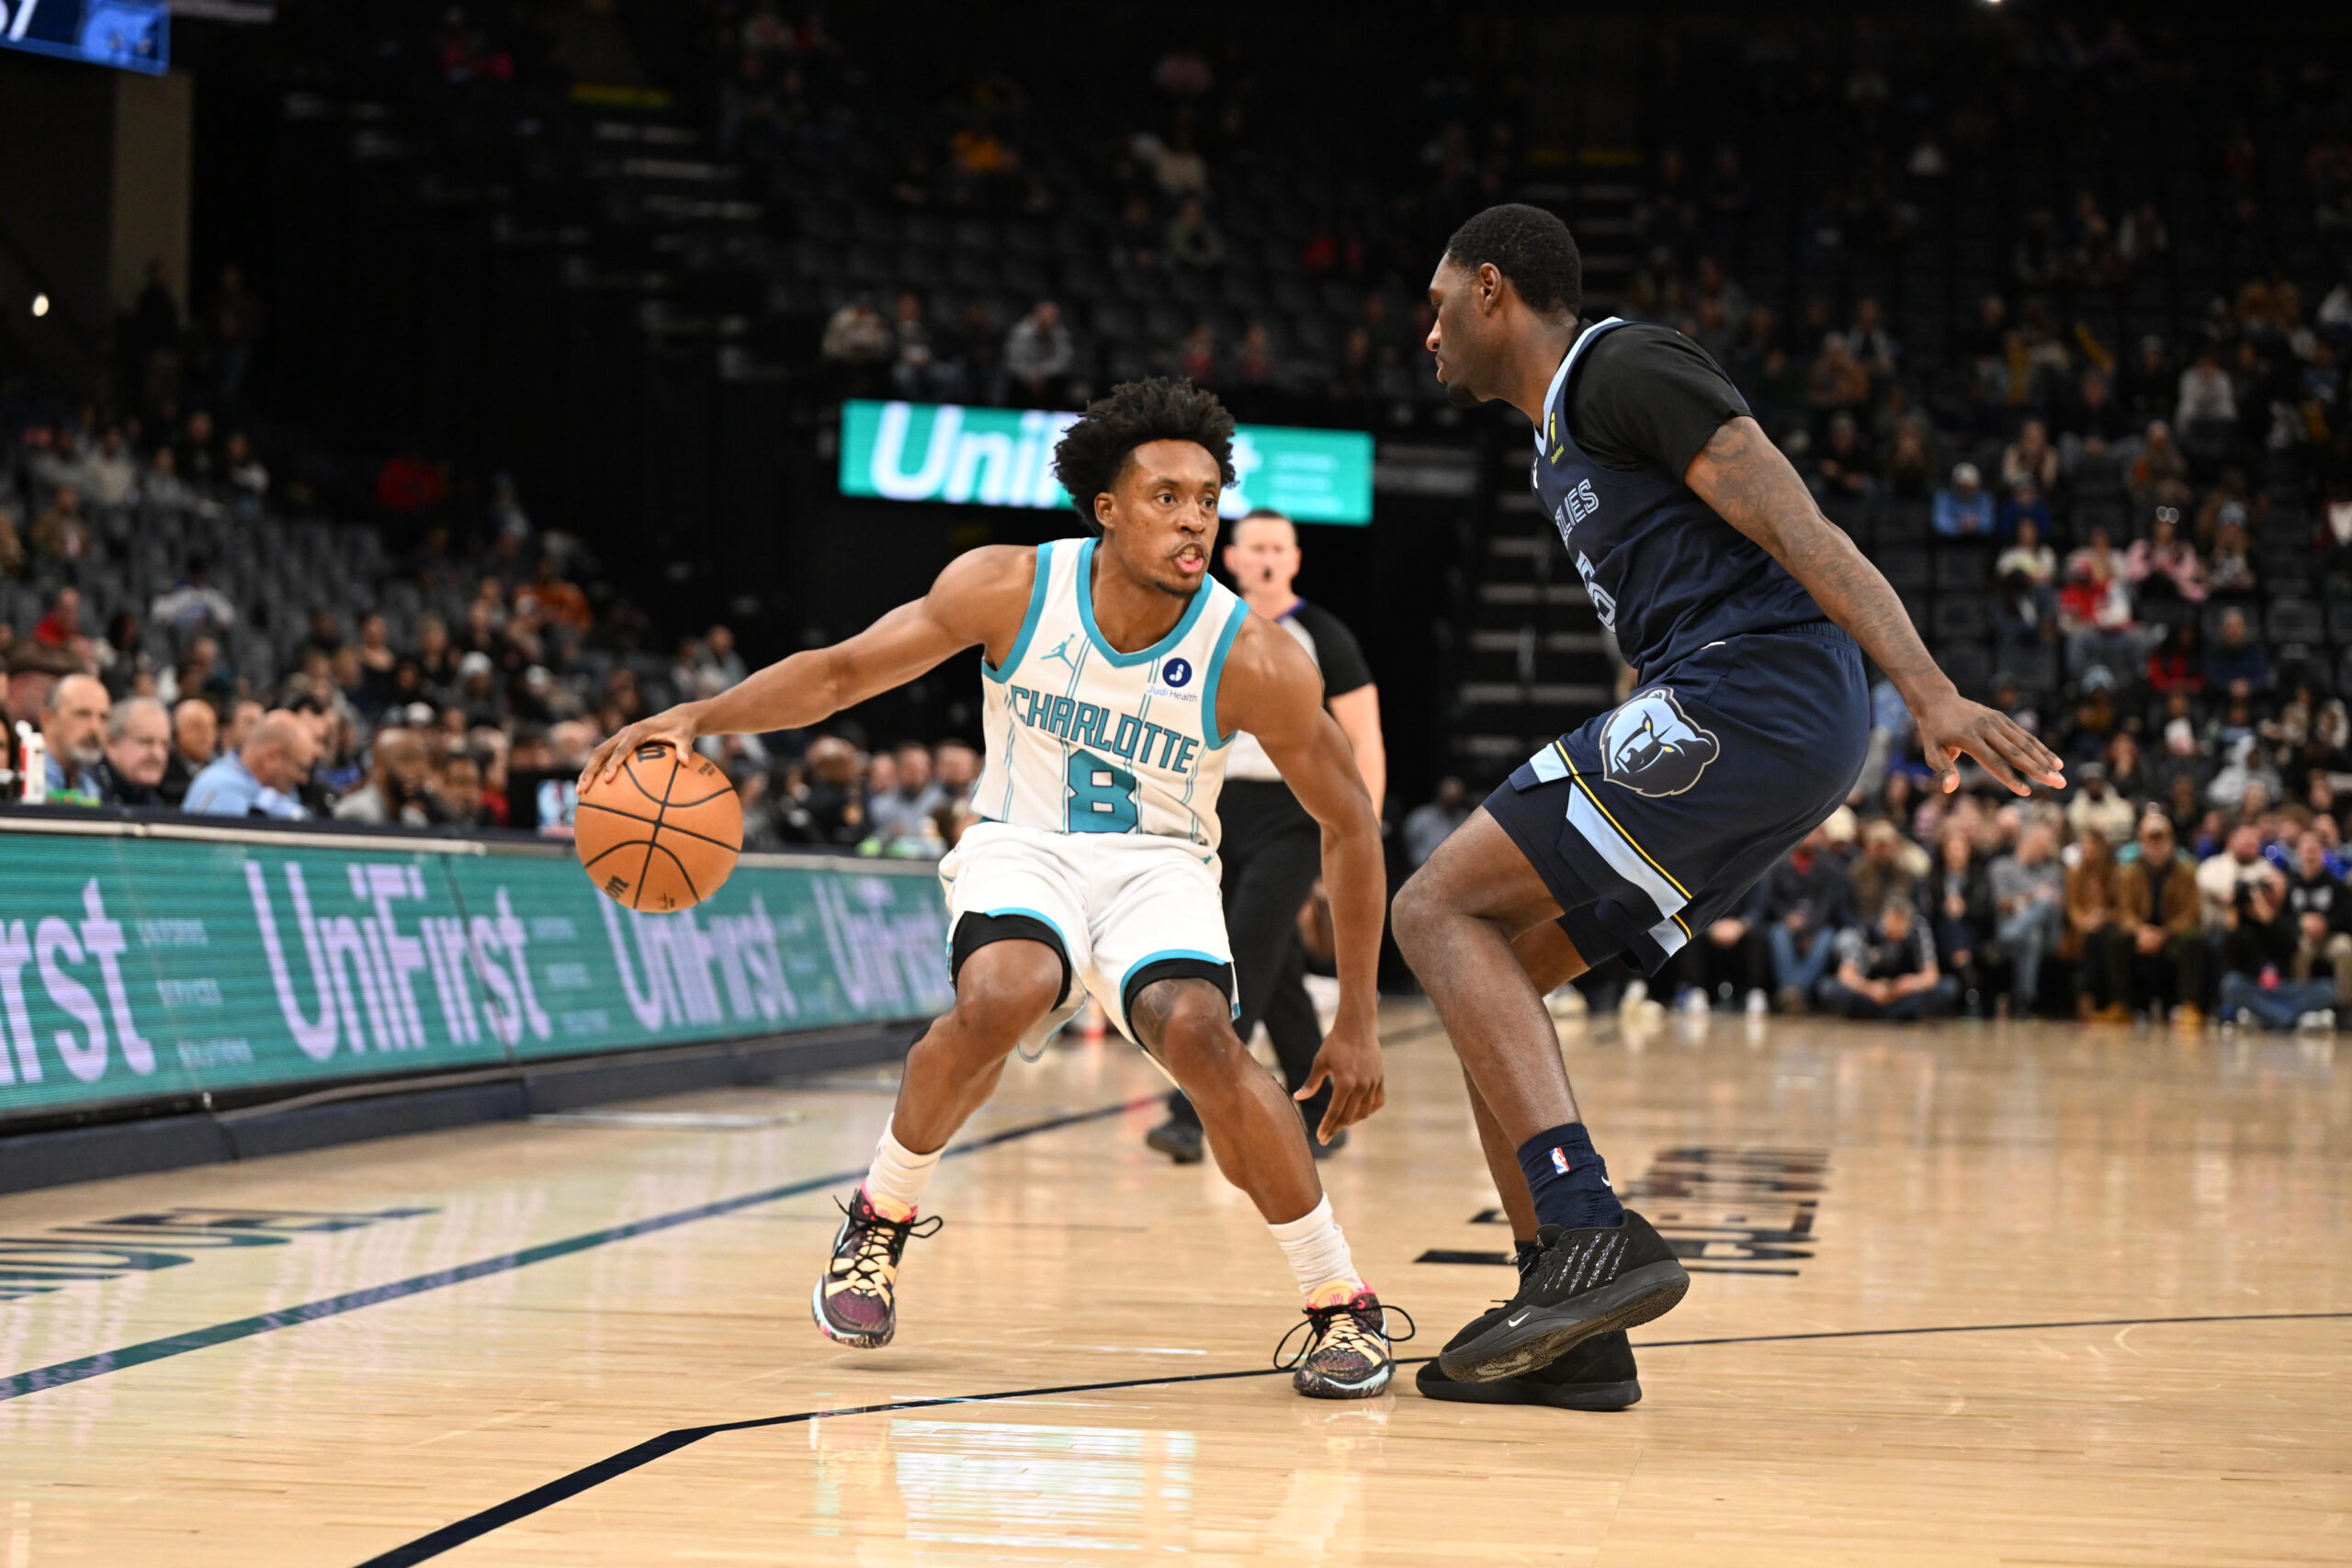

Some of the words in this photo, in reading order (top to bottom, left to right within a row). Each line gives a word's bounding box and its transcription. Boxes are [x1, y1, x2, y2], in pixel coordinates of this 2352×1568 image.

[1555, 478, 1600, 549] LIES
[1011, 684, 1199, 773] CHARLOTTE
[1147, 685, 1169, 697] Judi
[1170, 689, 1198, 703] Health
[1068, 749, 1139, 834] 8
[243, 860, 551, 1062] UniFirst
